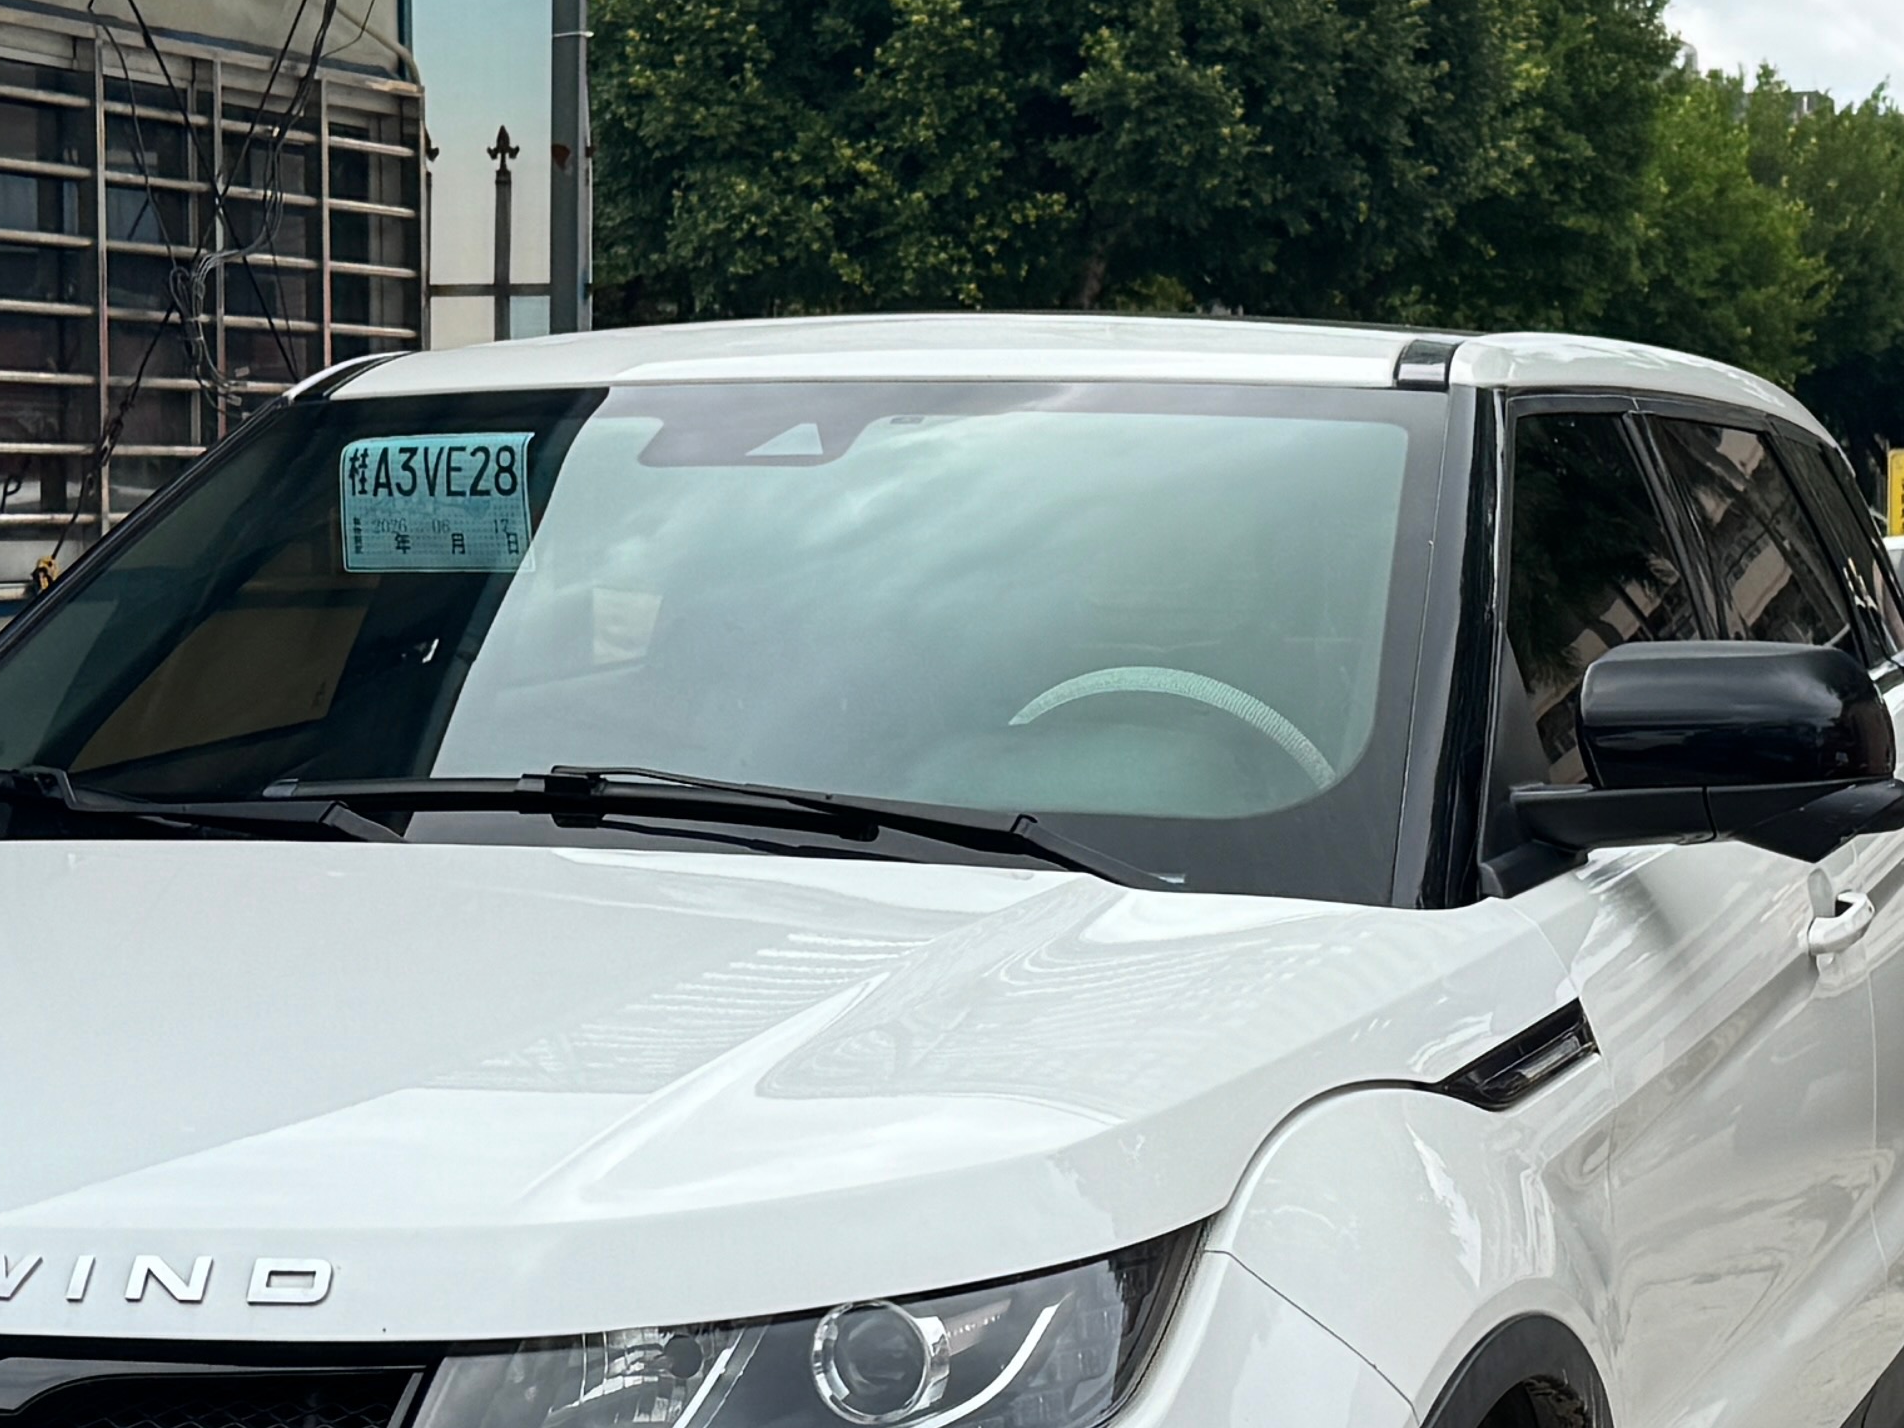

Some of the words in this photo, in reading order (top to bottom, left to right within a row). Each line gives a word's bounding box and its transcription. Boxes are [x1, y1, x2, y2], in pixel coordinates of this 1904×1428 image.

[349, 445, 518, 497] 桂A3VE28
[395, 532, 411, 554] 年
[451, 533, 466, 554] 月
[506, 532, 520, 554] 日
